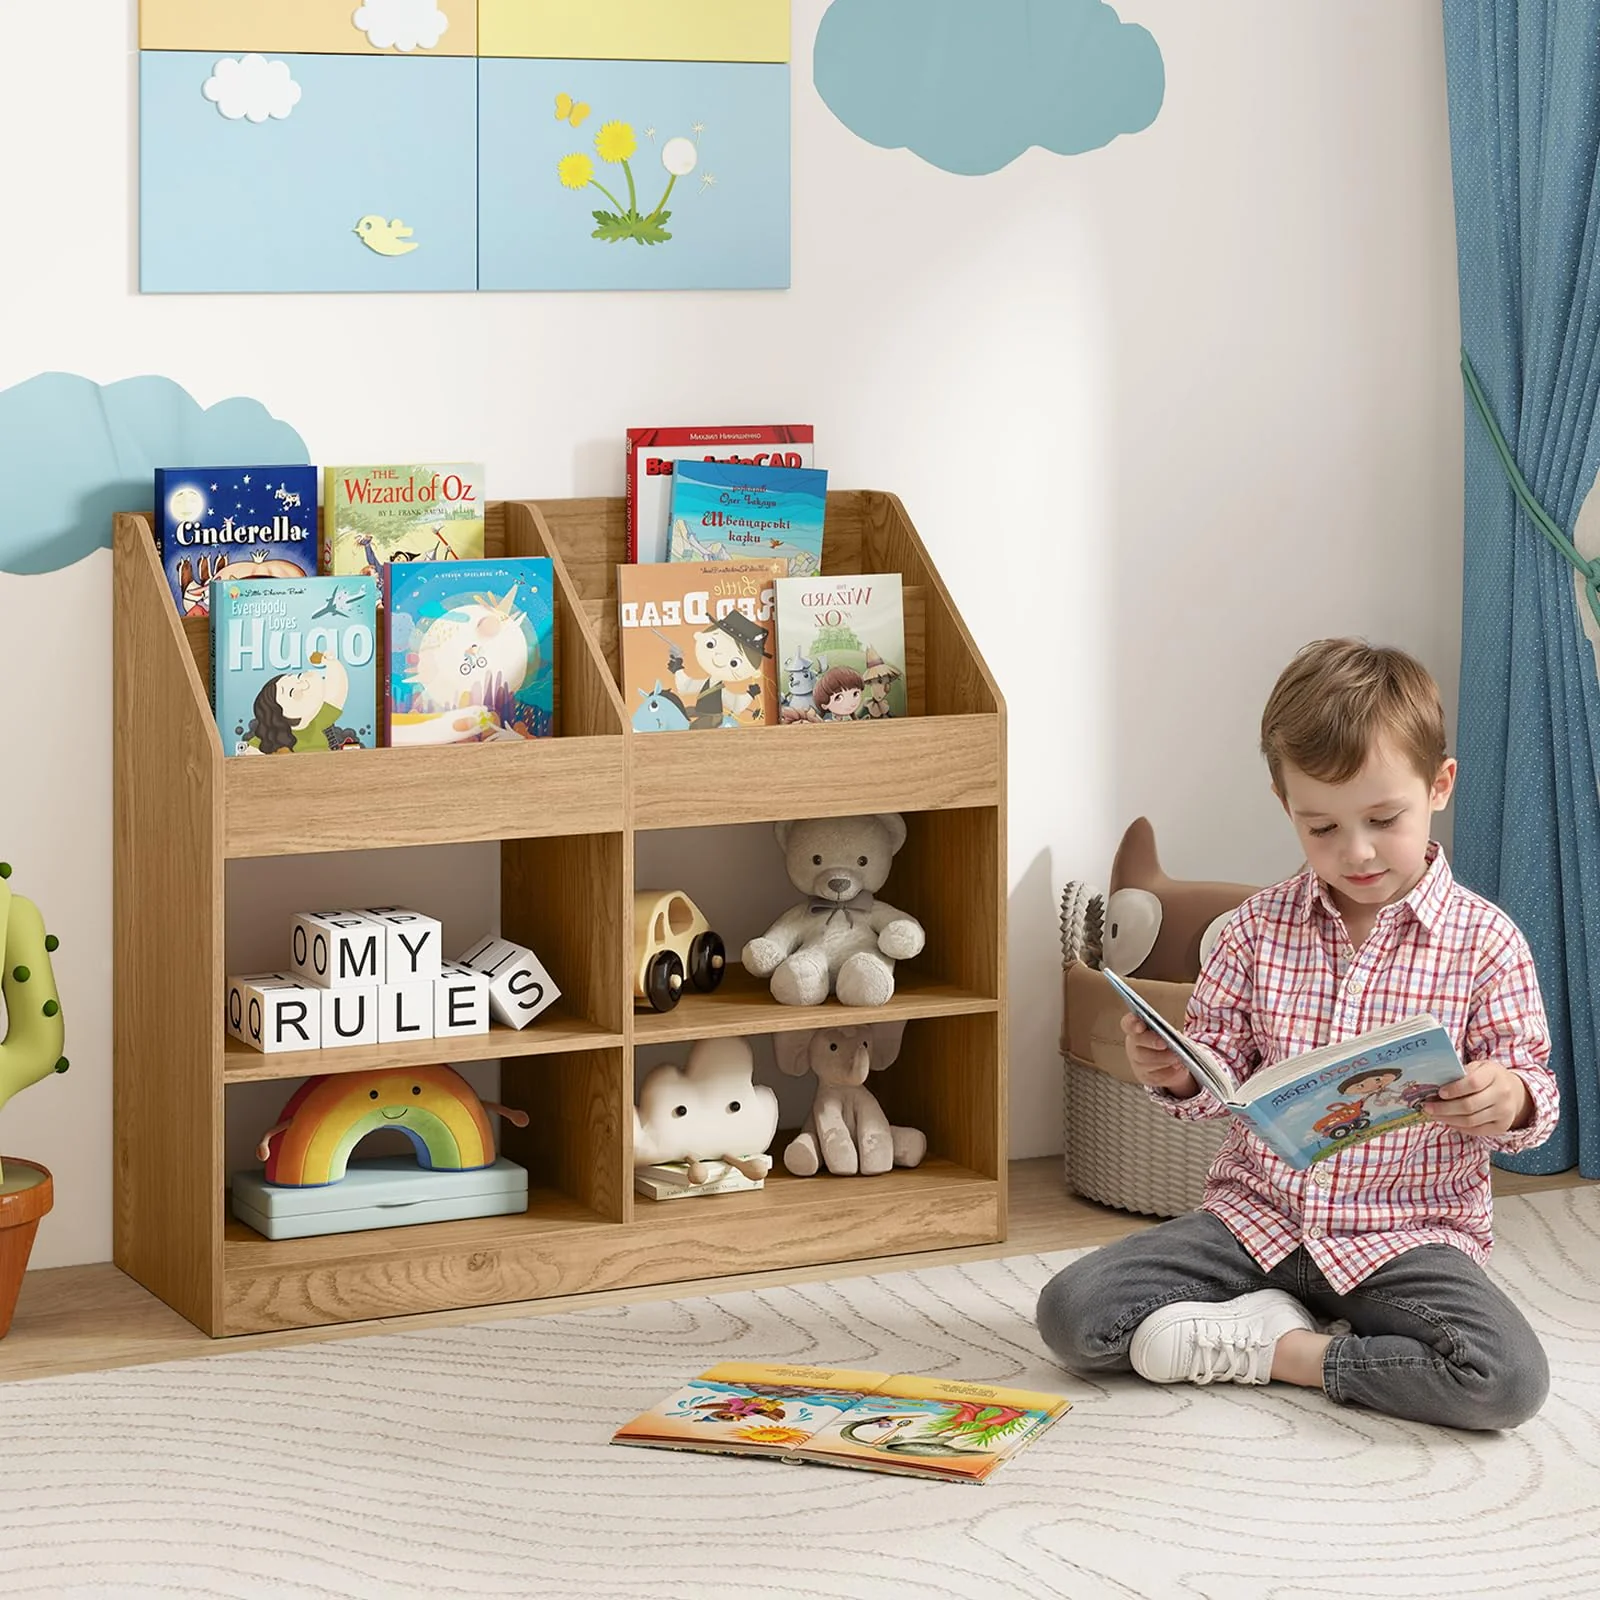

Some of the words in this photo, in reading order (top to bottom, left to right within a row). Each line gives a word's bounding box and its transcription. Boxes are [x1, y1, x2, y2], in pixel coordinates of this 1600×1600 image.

[371, 469, 398, 480] THE
[344, 476, 414, 505] Wizard
[417, 473, 441, 502] of
[442, 474, 478, 502] Oz
[377, 509, 387, 517] BY
[398, 508, 422, 517] FRANK
[701, 511, 791, 531] Швейцарські
[175, 516, 303, 546] Cinderella
[728, 529, 761, 546] казки
[232, 600, 287, 617] Everybody
[269, 616, 297, 631] Loves
[339, 931, 431, 979] MY
[276, 969, 544, 1043] RULES
